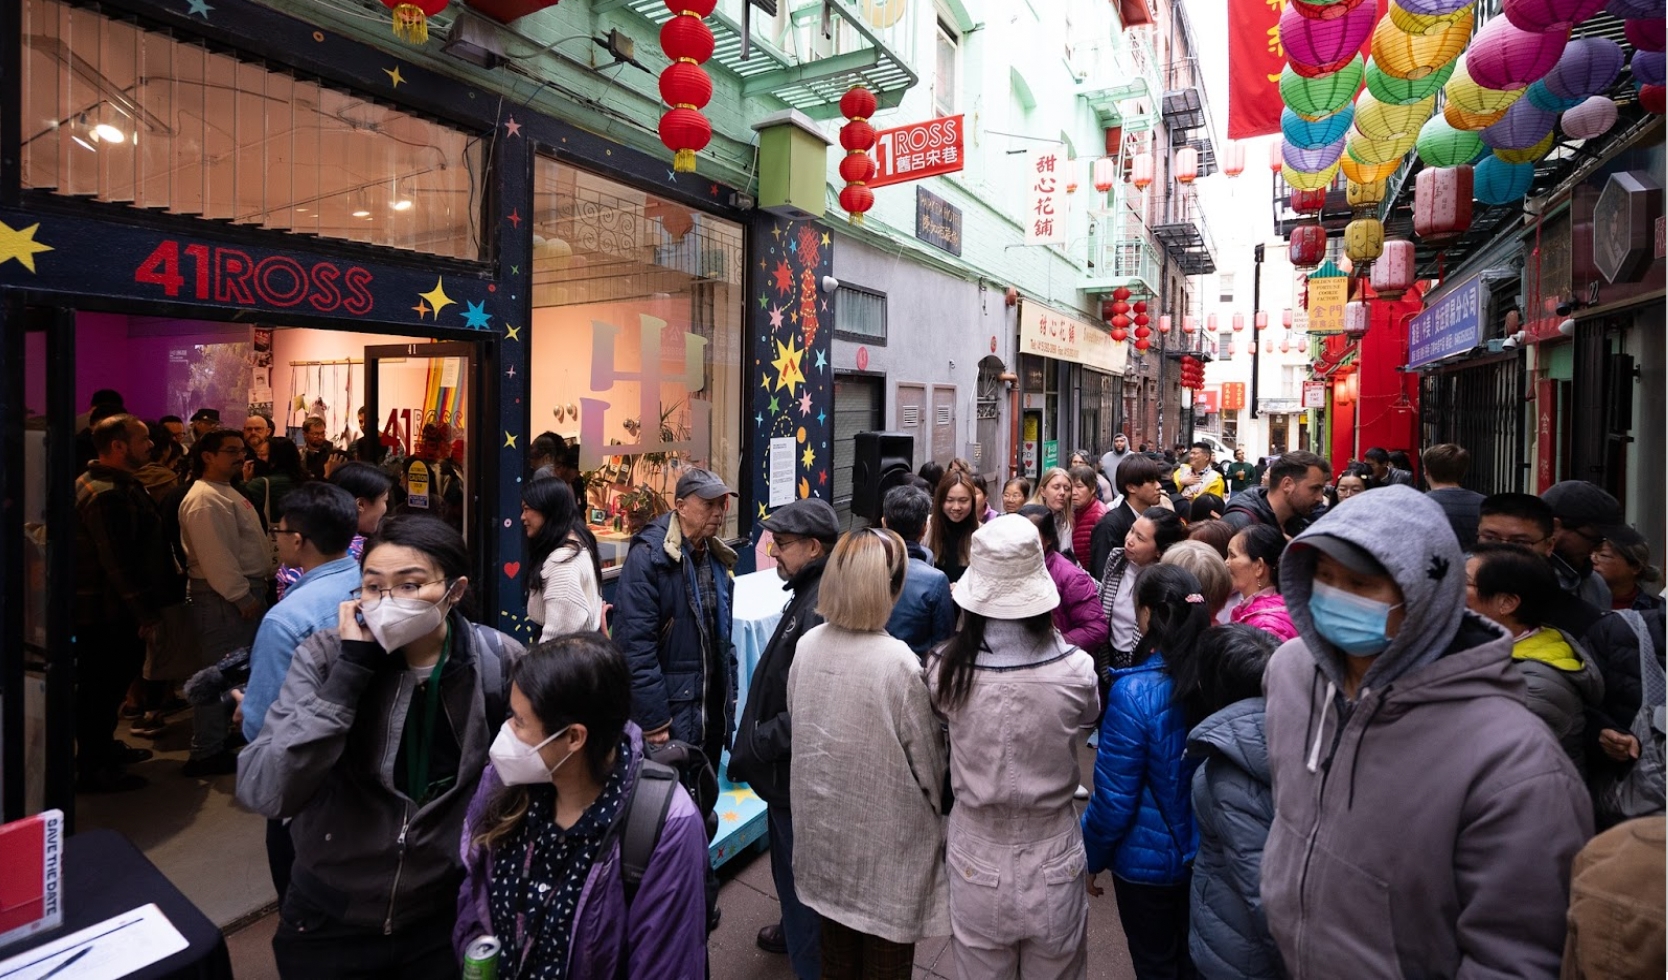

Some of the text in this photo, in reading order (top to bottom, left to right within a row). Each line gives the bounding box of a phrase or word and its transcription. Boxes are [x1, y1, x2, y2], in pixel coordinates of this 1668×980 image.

[896, 146, 958, 173] 舊呂宋巷
[1588, 280, 1599, 305] 22
[1312, 304, 1343, 318] 金門
[408, 344, 417, 354] 41
[409, 474, 427, 482] CAUTION
[46, 818, 58, 916] SAVE THE DATE
